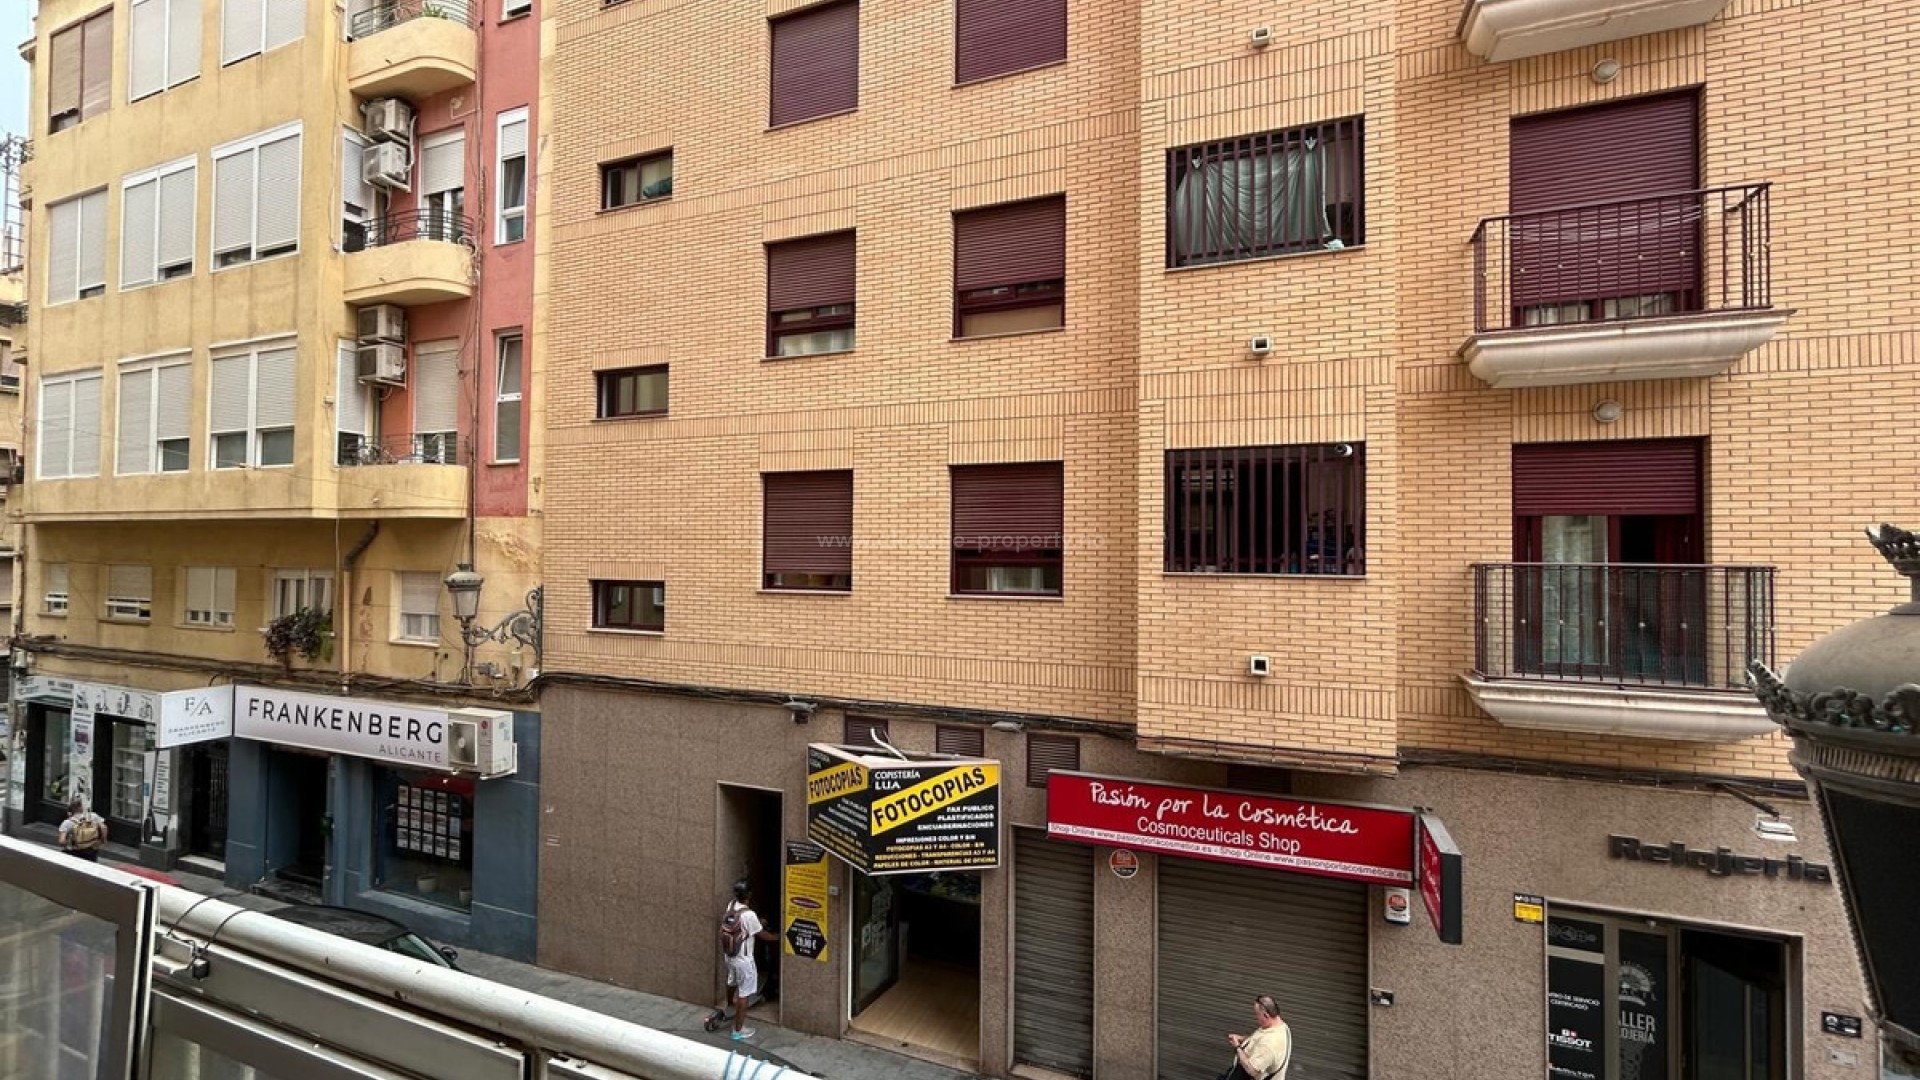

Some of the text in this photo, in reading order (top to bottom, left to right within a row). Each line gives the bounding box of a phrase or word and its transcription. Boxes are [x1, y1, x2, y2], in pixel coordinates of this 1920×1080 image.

[249, 698, 442, 744] FRANKENBERG
[379, 744, 441, 763] ALICANTE
[809, 766, 863, 799] FOTOCOPIAS
[874, 769, 921, 779] COPISTERÍA
[874, 781, 901, 790] LUA
[873, 767, 986, 827] FOTOCOPIAS
[1089, 782, 1359, 834] Pasión por la Cosmética
[937, 813, 994, 821] PLASTIFICADOS
[1137, 816, 1301, 855] Cosmoceuticals Shop
[1549, 1033, 1593, 1048] TISSOT
